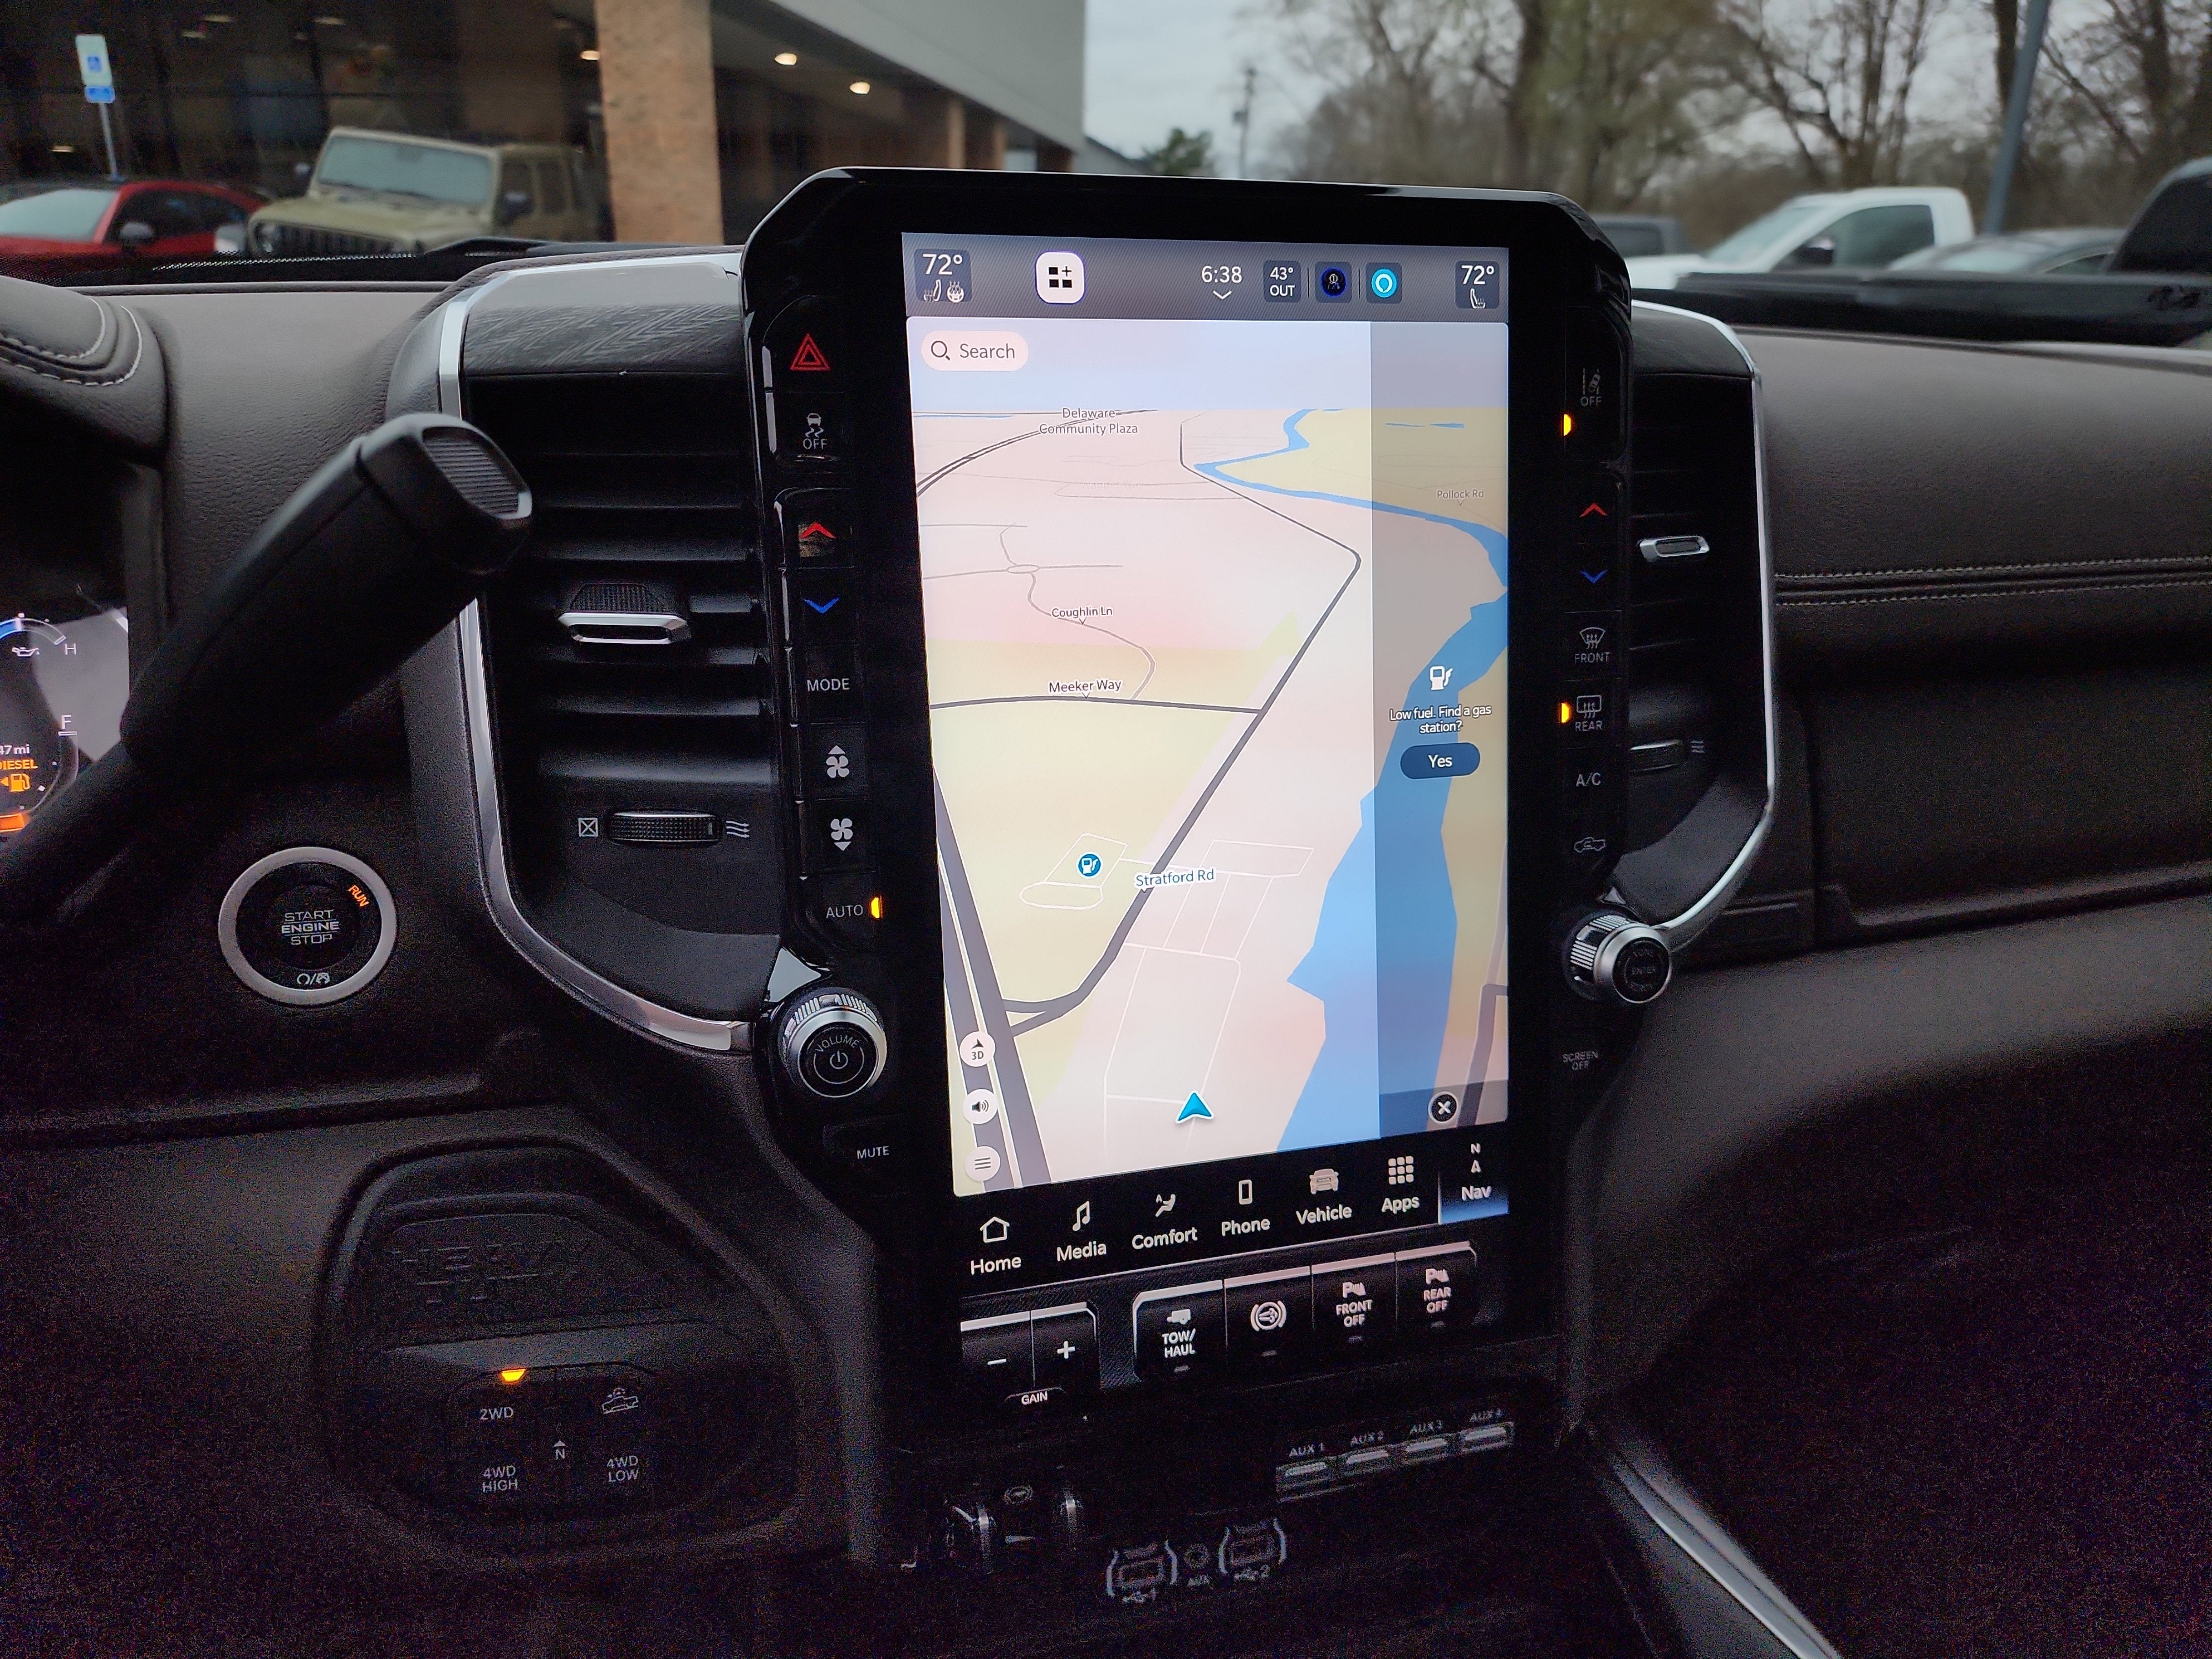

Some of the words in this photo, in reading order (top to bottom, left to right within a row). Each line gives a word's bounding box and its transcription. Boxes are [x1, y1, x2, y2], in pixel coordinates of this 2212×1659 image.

[922, 254, 962, 275] 72°
[1202, 266, 1242, 283] 6:38
[1270, 267, 1294, 280] 43°
[1461, 265, 1495, 285] 72°
[1270, 285, 1295, 297] OUT
[960, 343, 1015, 359] Search
[1580, 396, 1602, 407] OFF
[1062, 407, 1115, 418] Delaware
[1039, 423, 1106, 436] Community
[1109, 424, 1138, 434] Plaza
[803, 438, 828, 450] OFF
[1437, 490, 1470, 499] Pollock
[1472, 489, 1484, 498] Rd
[1052, 606, 1098, 619] Coughlin
[1101, 606, 1113, 616] Ln
[65, 644, 76, 654] H
[1575, 652, 1610, 663] FRONT
[807, 678, 850, 692] MODE
[1049, 681, 1094, 693] Meeker
[1096, 679, 1121, 691] Way
[1389, 709, 1411, 721] Low
[1414, 706, 1436, 719] fuel.
[1439, 704, 1462, 717] Find
[1472, 706, 1492, 718] gas
[61, 715, 71, 730] F
[1420, 720, 1462, 734] station?
[1575, 720, 1603, 732] REAR
[14, 743, 30, 755] mi
[1428, 754, 1452, 768] Yes
[1576, 772, 1601, 787] A/C
[1136, 870, 1193, 886] Stratford
[1198, 869, 1214, 881] Rd
[348, 885, 369, 907] RUN
[285, 909, 334, 922] START
[826, 904, 863, 918] AUTO
[281, 922, 340, 934] ENGINE
[291, 934, 332, 945] STOP
[815, 1035, 860, 1053] VOLUME
[971, 1051, 984, 1060] 3D
[1563, 1050, 1598, 1064] SCREEN
[1572, 1060, 1589, 1071] OFF
[857, 1146, 890, 1160] MUTE
[1461, 1185, 1491, 1201] Nav
[1381, 1195, 1420, 1214] Apps
[1295, 1204, 1352, 1225] Vehicle
[1221, 1218, 1271, 1237] Phone
[1132, 1227, 1198, 1250] Comfort
[1056, 1241, 1107, 1262] Media
[970, 1256, 1022, 1275] Home
[1424, 1286, 1452, 1301] REAR
[1336, 1299, 1373, 1316] FRONT
[1426, 1300, 1449, 1314] OFF
[1344, 1313, 1365, 1328] OFF
[1162, 1328, 1196, 1345] TOW/
[1164, 1344, 1195, 1358] HAUL
[1021, 1391, 1048, 1405] GAIN
[480, 1406, 514, 1421] 2WD
[1409, 1422, 1435, 1435] AUX
[1350, 1432, 1376, 1446] AUX
[556, 1449, 565, 1459] N
[1288, 1444, 1315, 1457] AUX
[606, 1455, 638, 1469] 4WD
[483, 1465, 516, 1479] 4WD
[608, 1469, 639, 1483] LOW
[482, 1479, 518, 1493] HIGH
